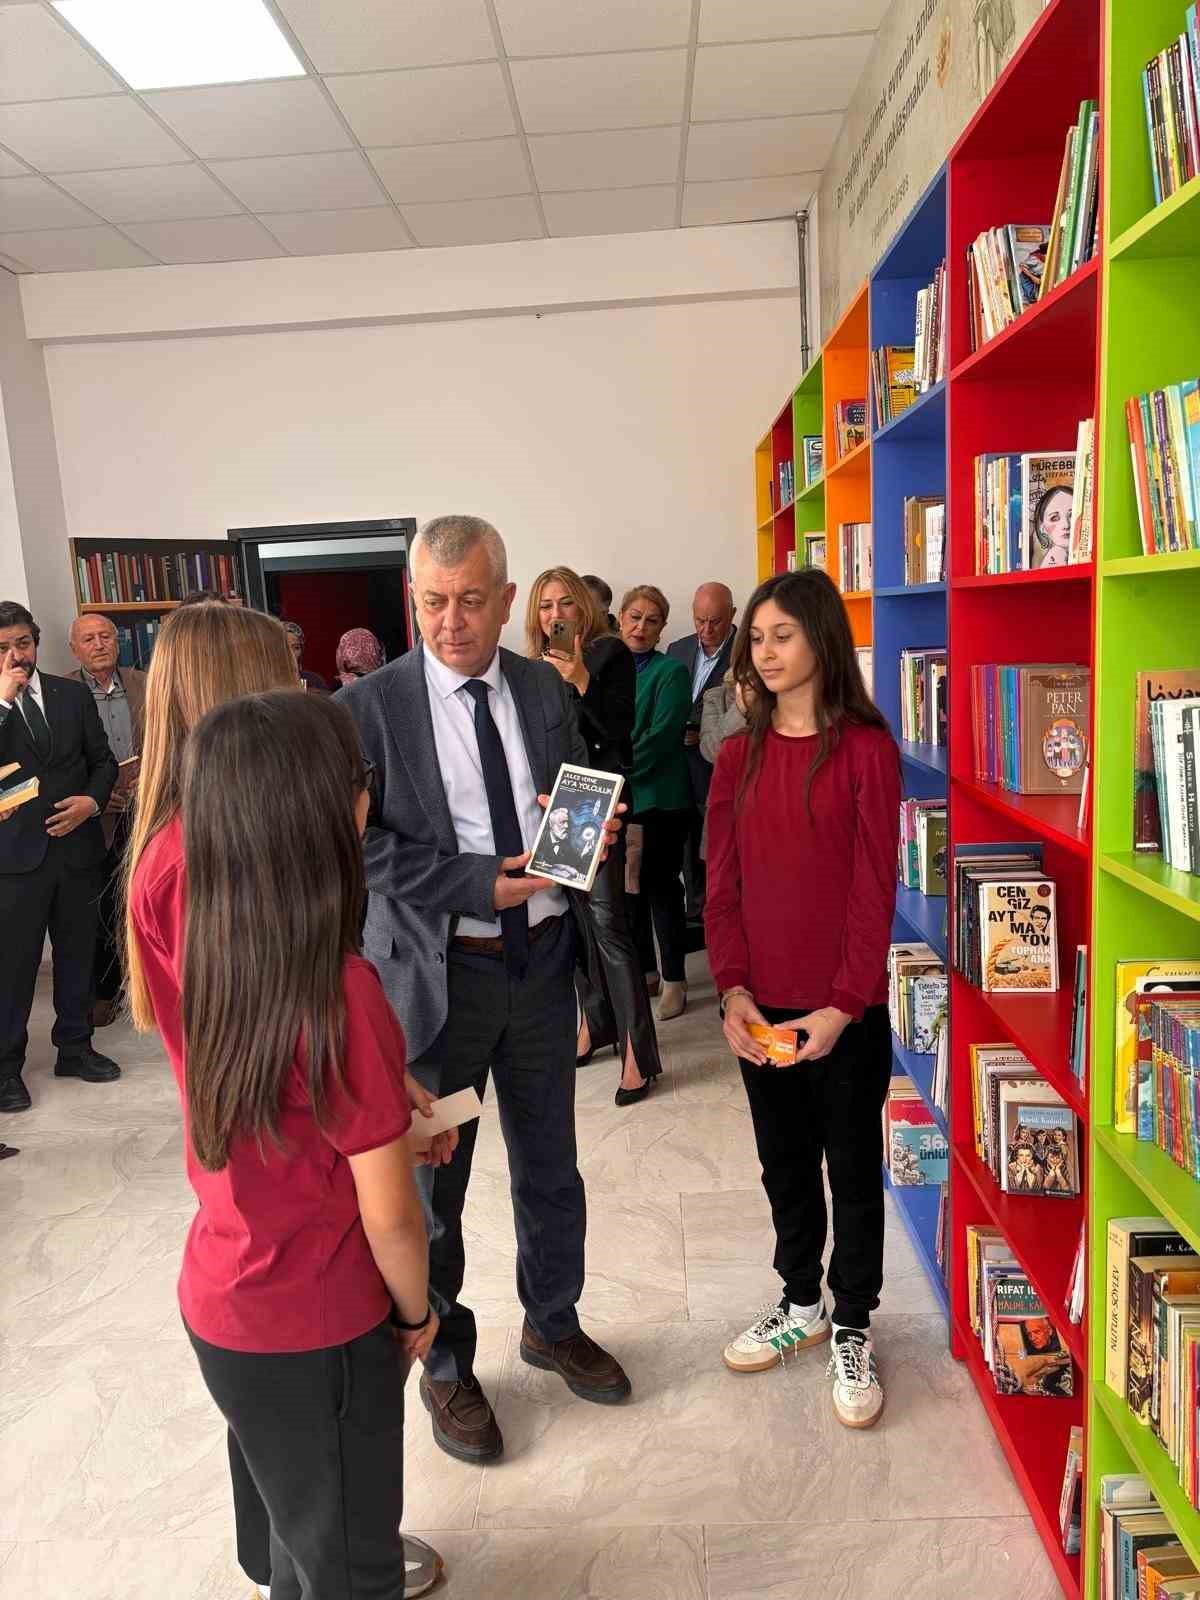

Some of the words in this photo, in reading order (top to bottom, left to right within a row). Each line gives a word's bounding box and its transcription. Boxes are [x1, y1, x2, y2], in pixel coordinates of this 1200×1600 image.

[1047, 691, 1083, 704] PETER
[1052, 703, 1077, 714] PAN
[997, 886, 1026, 898] CEN
[988, 910, 1016, 922] AYT
[1010, 922, 1035, 934] MA
[1020, 934, 1050, 947] TOV
